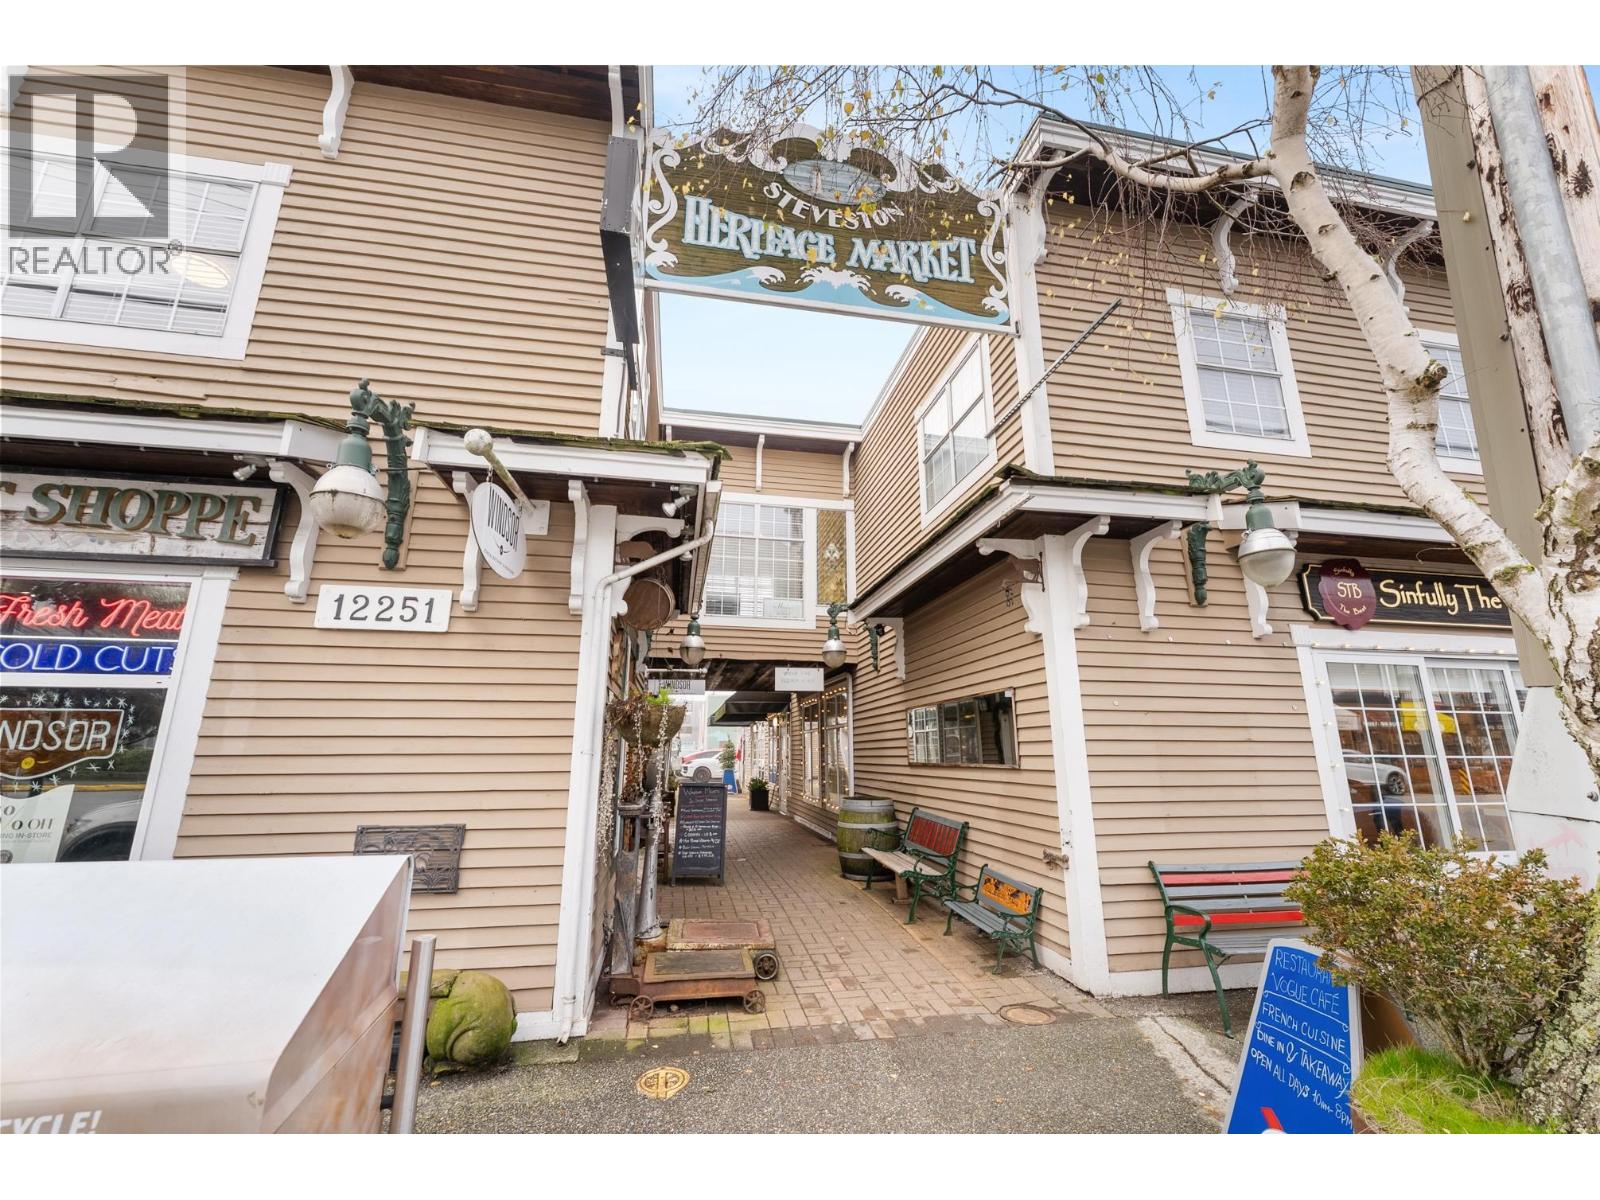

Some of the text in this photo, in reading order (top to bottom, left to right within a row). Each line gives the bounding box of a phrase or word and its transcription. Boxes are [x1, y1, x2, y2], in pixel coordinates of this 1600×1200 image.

[763, 182, 905, 231] STEVESTON
[682, 194, 977, 284] HERITAGE MARKET
[23, 482, 262, 547] SHOPPE
[488, 485, 520, 553] WINDSOR
[0, 594, 89, 628] Fresh
[333, 593, 436, 625] 12251
[1337, 581, 1362, 599] STB
[1379, 579, 1503, 616] Sinfully The
[1271, 972, 1340, 1015] VOGUE CAFÉ
[1262, 1002, 1345, 1055] FRENCH CUISINE
[1250, 1047, 1272, 1072] OPEN
[1273, 1064, 1286, 1083] ALL
[1288, 1073, 1310, 1098] DAYS
[1257, 1029, 1275, 1047] DINE
[1276, 1041, 1285, 1054] IN
[1300, 1048, 1349, 1099] TAKEAWAY
